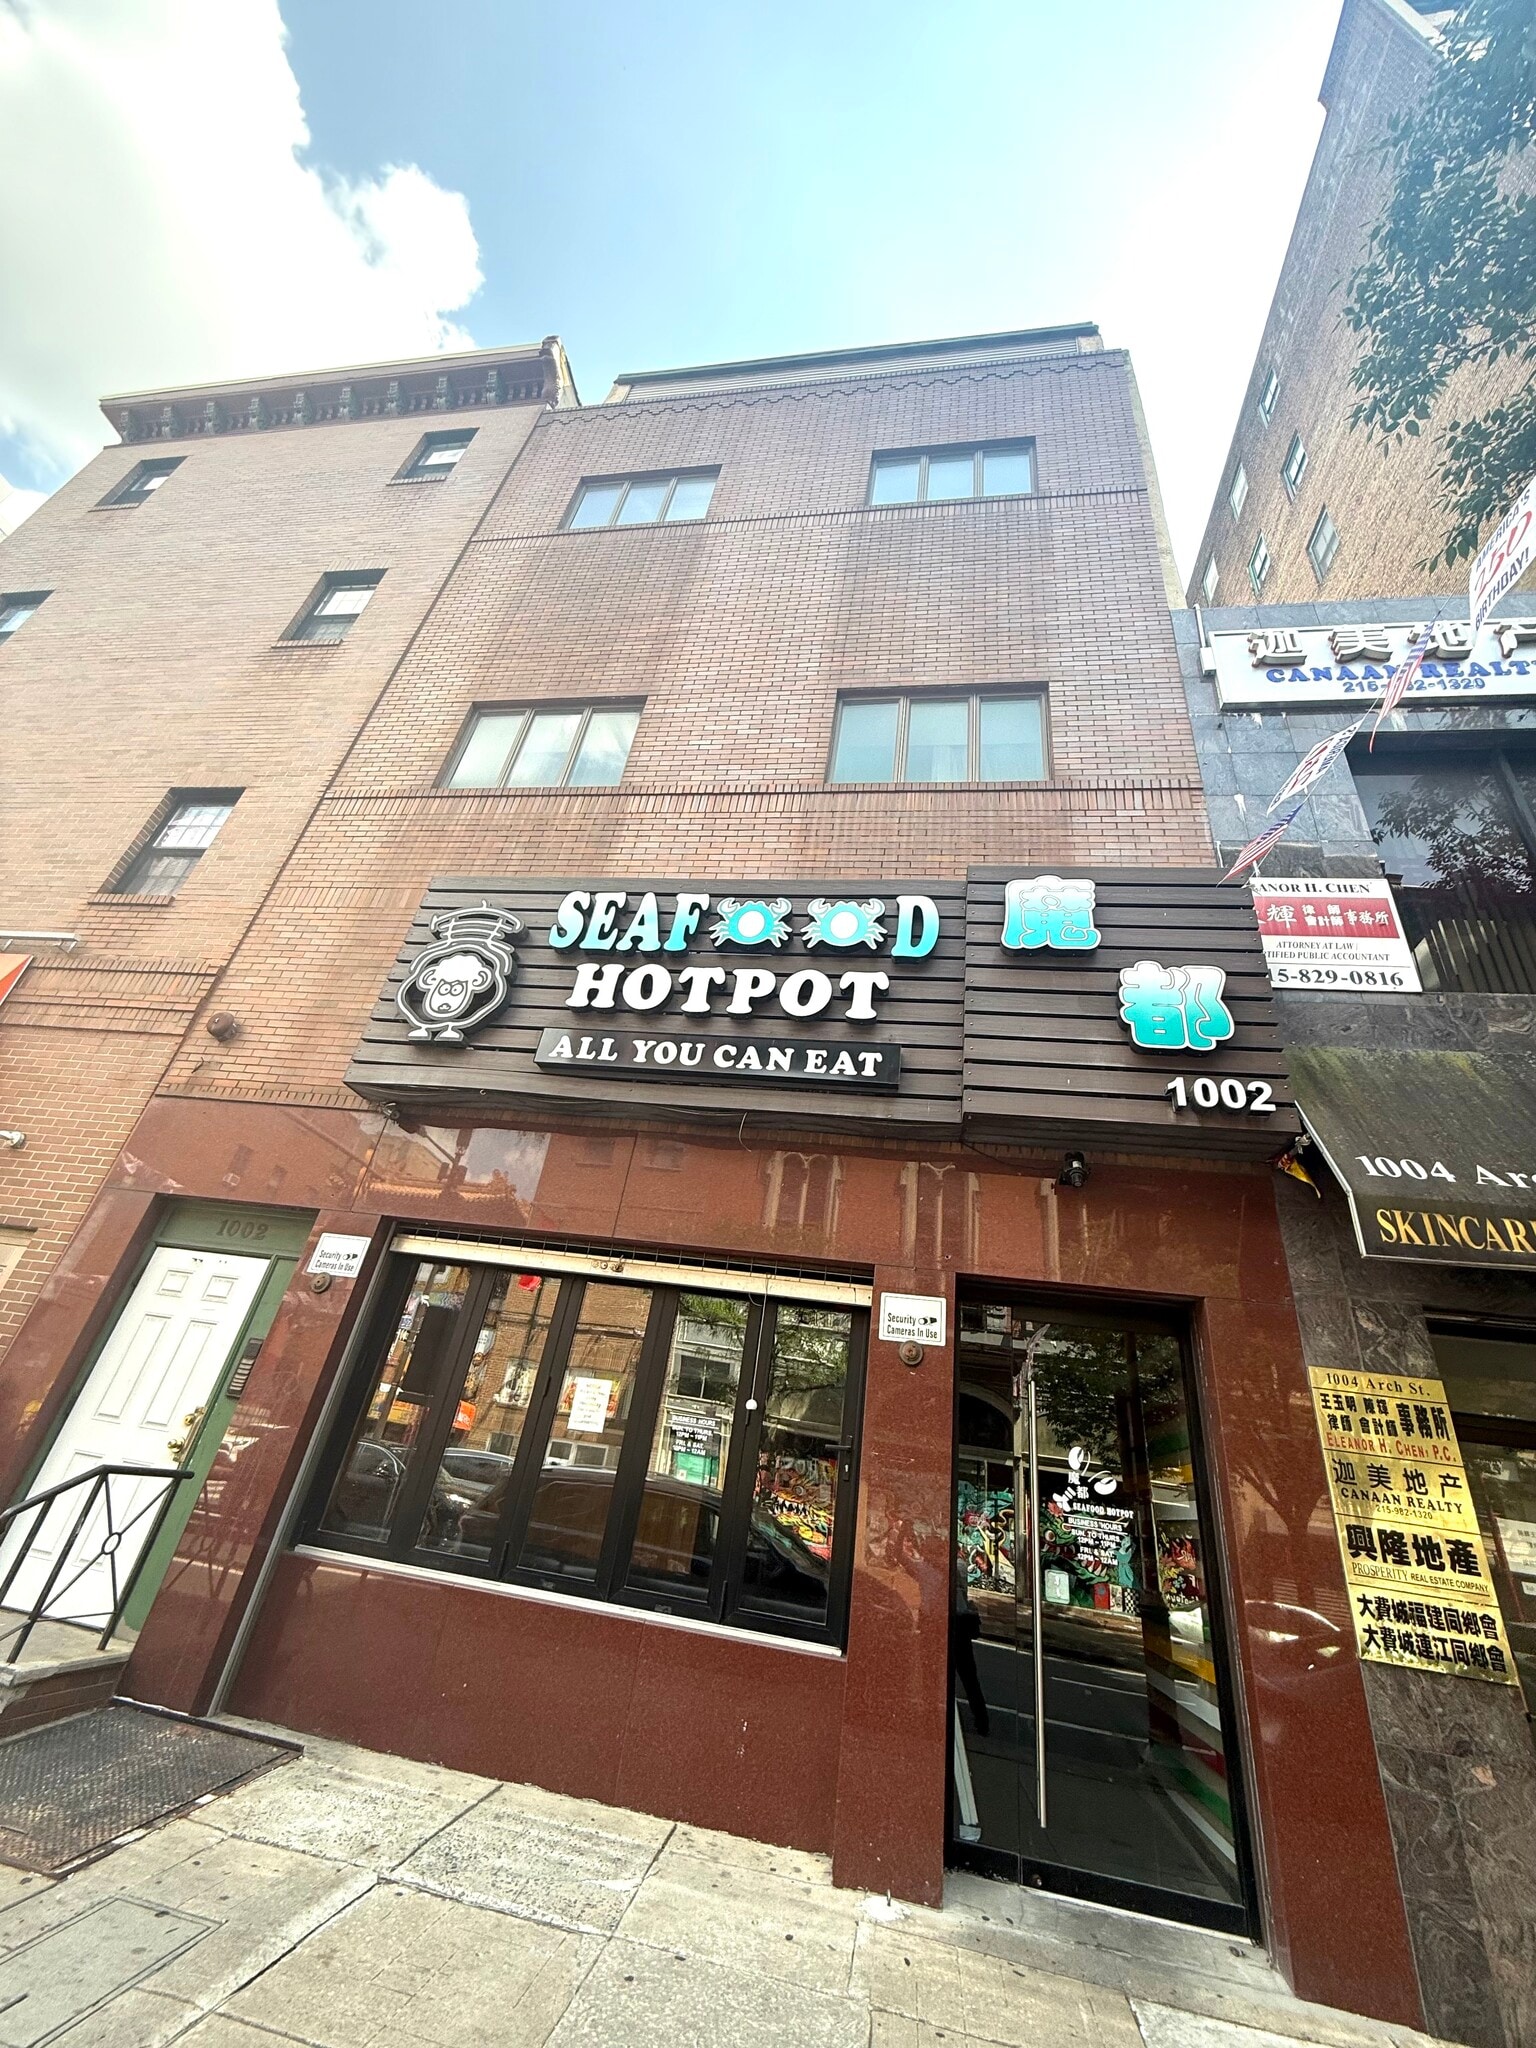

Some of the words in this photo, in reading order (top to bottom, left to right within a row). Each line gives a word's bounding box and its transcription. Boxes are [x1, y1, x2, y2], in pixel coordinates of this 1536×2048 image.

[1474, 510, 1533, 608] 250
[1475, 546, 1530, 631] BIRTHDAY!
[1420, 659, 1536, 679] REALT
[1304, 883, 1322, 893] H.
[1326, 883, 1371, 894] CHEN
[1276, 941, 1321, 949] ATTORNEY
[1335, 942, 1354, 950] LAW
[1297, 951, 1330, 960] PUBLIC
[1331, 952, 1390, 961] ACCOUNTANT
[565, 963, 889, 1022] HOTPOT
[549, 1035, 618, 1062] ALL
[632, 1039, 706, 1067] YOU
[713, 1044, 795, 1071] CAN
[803, 1049, 883, 1077] EAT
[1166, 1077, 1276, 1112] 1002
[1355, 1155, 1456, 1184] 1004
[1475, 1164, 1536, 1189] Ar
[216, 1219, 269, 1241] 1002
[315, 1259, 338, 1270] Cameras
[344, 1262, 355, 1272] Use
[319, 1249, 341, 1262] Security
[887, 1312, 917, 1327] Security
[887, 1324, 916, 1337] Cameras
[917, 1327, 924, 1338] In
[925, 1328, 938, 1339] Use
[1326, 1372, 1359, 1388] 1004
[1366, 1379, 1403, 1393] Arch
[1408, 1382, 1430, 1397] St.
[1326, 1432, 1375, 1451] ELEANOR
[1378, 1438, 1392, 1454] H.
[1432, 1444, 1457, 1462] P.C.
[1332, 1458, 1462, 1498] 迦美地产
[1072, 1502, 1105, 1514] SEAFOOD
[1341, 1487, 1402, 1505] CANAAN
[1406, 1496, 1462, 1514] REALTY
[1099, 1522, 1122, 1531] HOURS
[1345, 1524, 1482, 1577] 興隆地產
[1352, 1562, 1408, 1581] PROSPERITY
[1410, 1573, 1428, 1584] REAL
[1430, 1575, 1455, 1587] ESTATE
[1455, 1579, 1489, 1593] COMPANY
